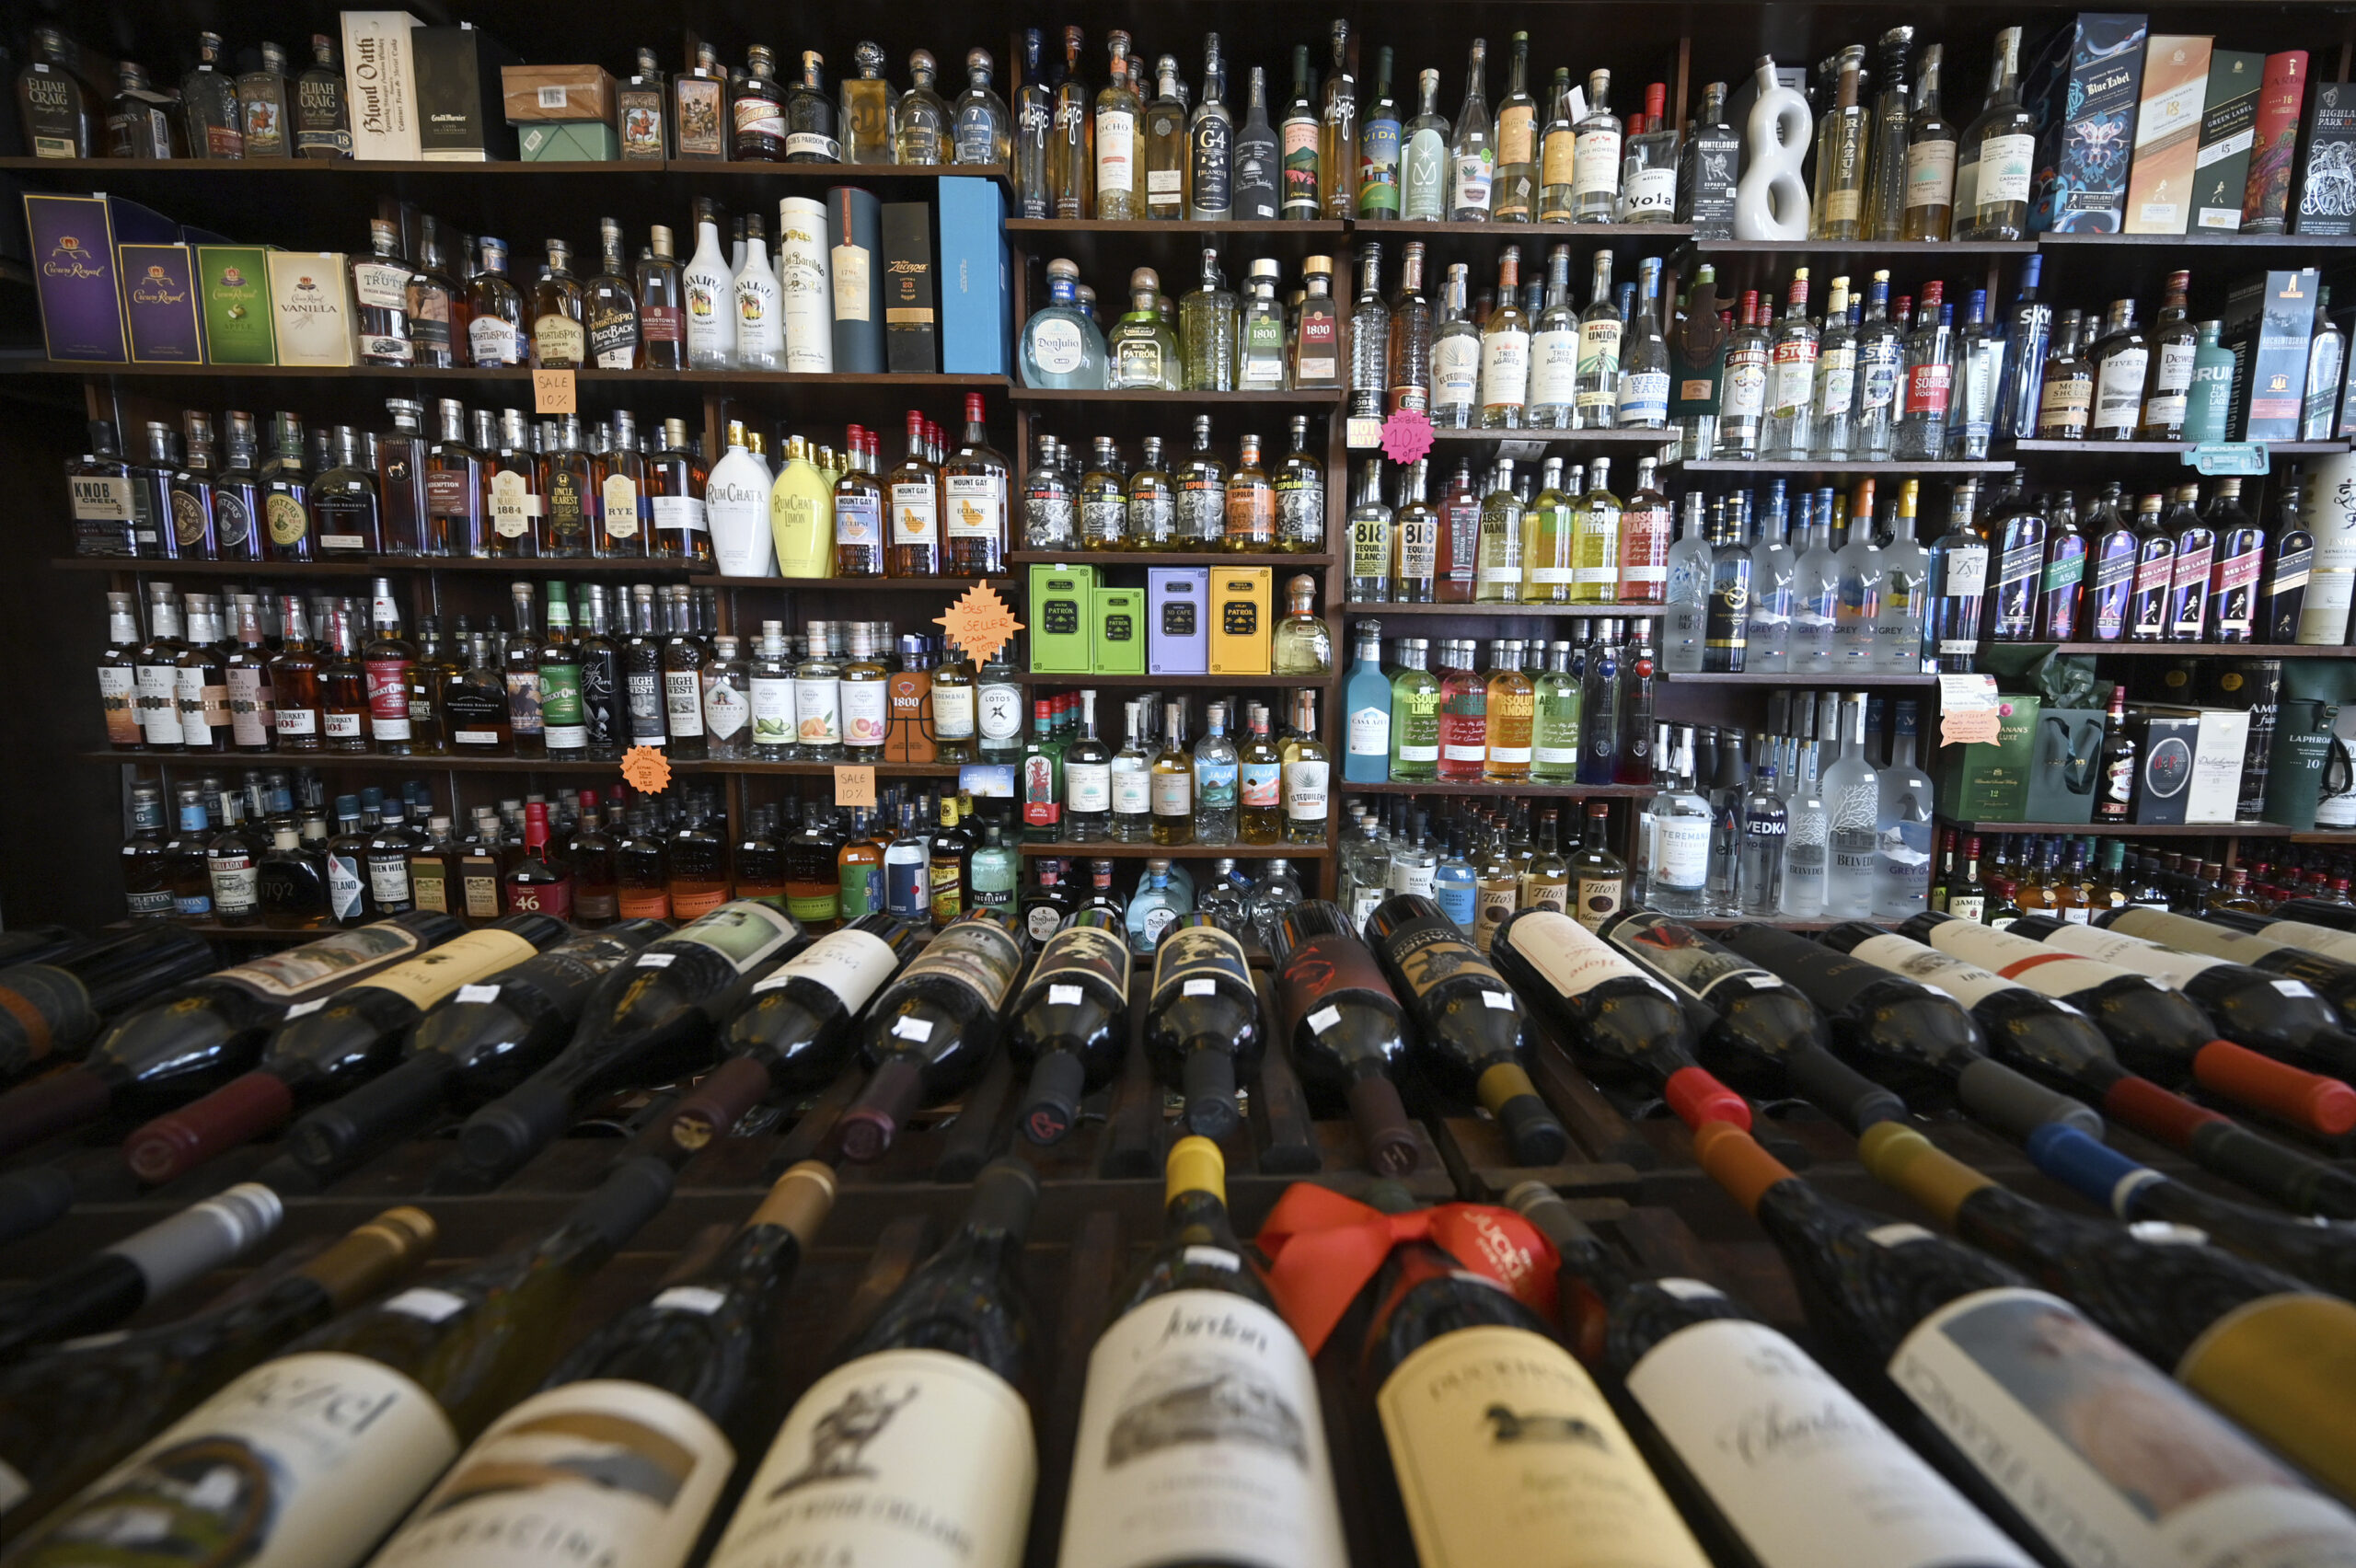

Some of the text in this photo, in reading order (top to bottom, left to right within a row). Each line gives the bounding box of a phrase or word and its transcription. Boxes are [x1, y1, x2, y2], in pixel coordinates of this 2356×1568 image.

[27, 77, 65, 93] ELIJAH
[300, 81, 334, 95] ELIJAH
[353, 33, 385, 140] Blood Oath
[2087, 75, 2130, 97] Blue Label
[29, 91, 67, 105] CRAIG
[300, 94, 335, 108] CRAIG
[2283, 95, 2292, 104] 16
[2166, 100, 2179, 115] 18
[914, 111, 921, 123] 7
[971, 109, 978, 121] 7
[1324, 96, 1355, 141] milagro
[2208, 105, 2253, 128] GREEN LABEL
[2320, 110, 2356, 119] HIGHLA
[1019, 101, 1049, 149] milagro
[1054, 98, 1082, 145] milagro
[2318, 117, 2342, 126] PARK
[1098, 124, 1128, 133] OCHO
[337, 134, 349, 144] 18
[802, 136, 825, 146] PARDON
[1200, 131, 1227, 148] G4
[1363, 133, 1397, 142] VIDA
[1698, 141, 1739, 149] MONTELOBOS
[1841, 118, 1859, 179] RIAZUL
[2222, 144, 2230, 154] 15
[44, 262, 104, 278] Crown Royal
[887, 261, 929, 273] Zacapa
[364, 274, 406, 288] TRUTH
[686, 275, 723, 295] MALIBU
[213, 288, 257, 301] Crown Royal
[735, 278, 773, 300] MALIBU
[133, 290, 184, 305] Crown Royal
[281, 305, 337, 313] VANILLA
[591, 311, 634, 331] WHISTLEPIG
[1253, 329, 1276, 339] 1800
[1306, 325, 1330, 335] 1800
[1037, 338, 1079, 351] Don Julio
[2263, 336, 2308, 347] AUCHENTOSHAN
[1779, 344, 1818, 358] STOLI
[1493, 358, 1519, 366] AGAVES
[1546, 357, 1573, 366] AGAVES
[1727, 352, 1768, 364] SMIRNOFF
[2108, 359, 2130, 367] FIVE
[538, 375, 568, 388] SALE
[1977, 353, 1990, 418] NEW AMSTERDAM
[542, 395, 567, 406] 10%
[1644, 400, 1664, 409] VODKA
[1392, 416, 1426, 425] DOBEL
[1350, 421, 1378, 433] HOT
[1350, 432, 1379, 445] BUY!
[1403, 448, 1423, 458] OFF
[953, 478, 972, 487] MOUNT
[75, 482, 110, 498] KNOB
[554, 487, 574, 496] UNCLE
[897, 487, 928, 496] MOUNT GAY
[497, 497, 522, 505] NEAREST
[551, 496, 580, 505] NEAREST
[116, 504, 122, 514] 9
[498, 506, 521, 514] 1884
[607, 508, 633, 516] RYE
[785, 511, 805, 527] LIMÓN
[1356, 525, 1387, 542] 818
[1405, 525, 1434, 543] 818
[1403, 546, 1434, 554] TEQUILA
[1356, 553, 1386, 561] BLANCO
[2002, 553, 2042, 570] BLACK LABEL
[1957, 559, 1982, 577] Zyr
[2050, 563, 2066, 573] BLACK
[2098, 560, 2134, 575] BLACK LABEL
[2176, 558, 2212, 573] RED LABEL
[2224, 559, 2260, 576] RED LABEL
[2059, 571, 2076, 583] 456
[2139, 564, 2172, 579] RED LABEL
[963, 602, 995, 615] BEST
[964, 617, 1010, 632] SELLER
[1750, 625, 1772, 634] GREY
[1798, 626, 1819, 634] GREY
[1835, 626, 1858, 634] GREY
[1877, 627, 1902, 635] GREY
[964, 634, 987, 644] CASA
[976, 641, 999, 652] LOTOS
[629, 676, 653, 686] HIGH
[666, 676, 693, 686] HIGH
[561, 689, 577, 698] OWL
[628, 686, 654, 694] WEST
[667, 686, 694, 695] WEST
[894, 698, 918, 707] 1800
[1403, 694, 1440, 704] ABSOLUT
[1449, 694, 1486, 705] ABSOLUT
[409, 707, 431, 715] HONEY
[1412, 704, 1434, 714] LIME
[281, 712, 306, 721] TURKEY
[329, 716, 352, 724] TURKEY
[2305, 758, 2319, 769] 10
[840, 774, 865, 784] SALE
[842, 789, 863, 799] 10%
[1746, 822, 1786, 835] VEDKA
[1716, 840, 1739, 857] elit
[212, 859, 244, 870] HOLLADAY
[1889, 867, 1914, 875] GREY
[1534, 887, 1564, 897] Tito's
[1586, 882, 1617, 894] Tito's
[515, 895, 540, 911] 46
[1484, 892, 1513, 903] Tito's
